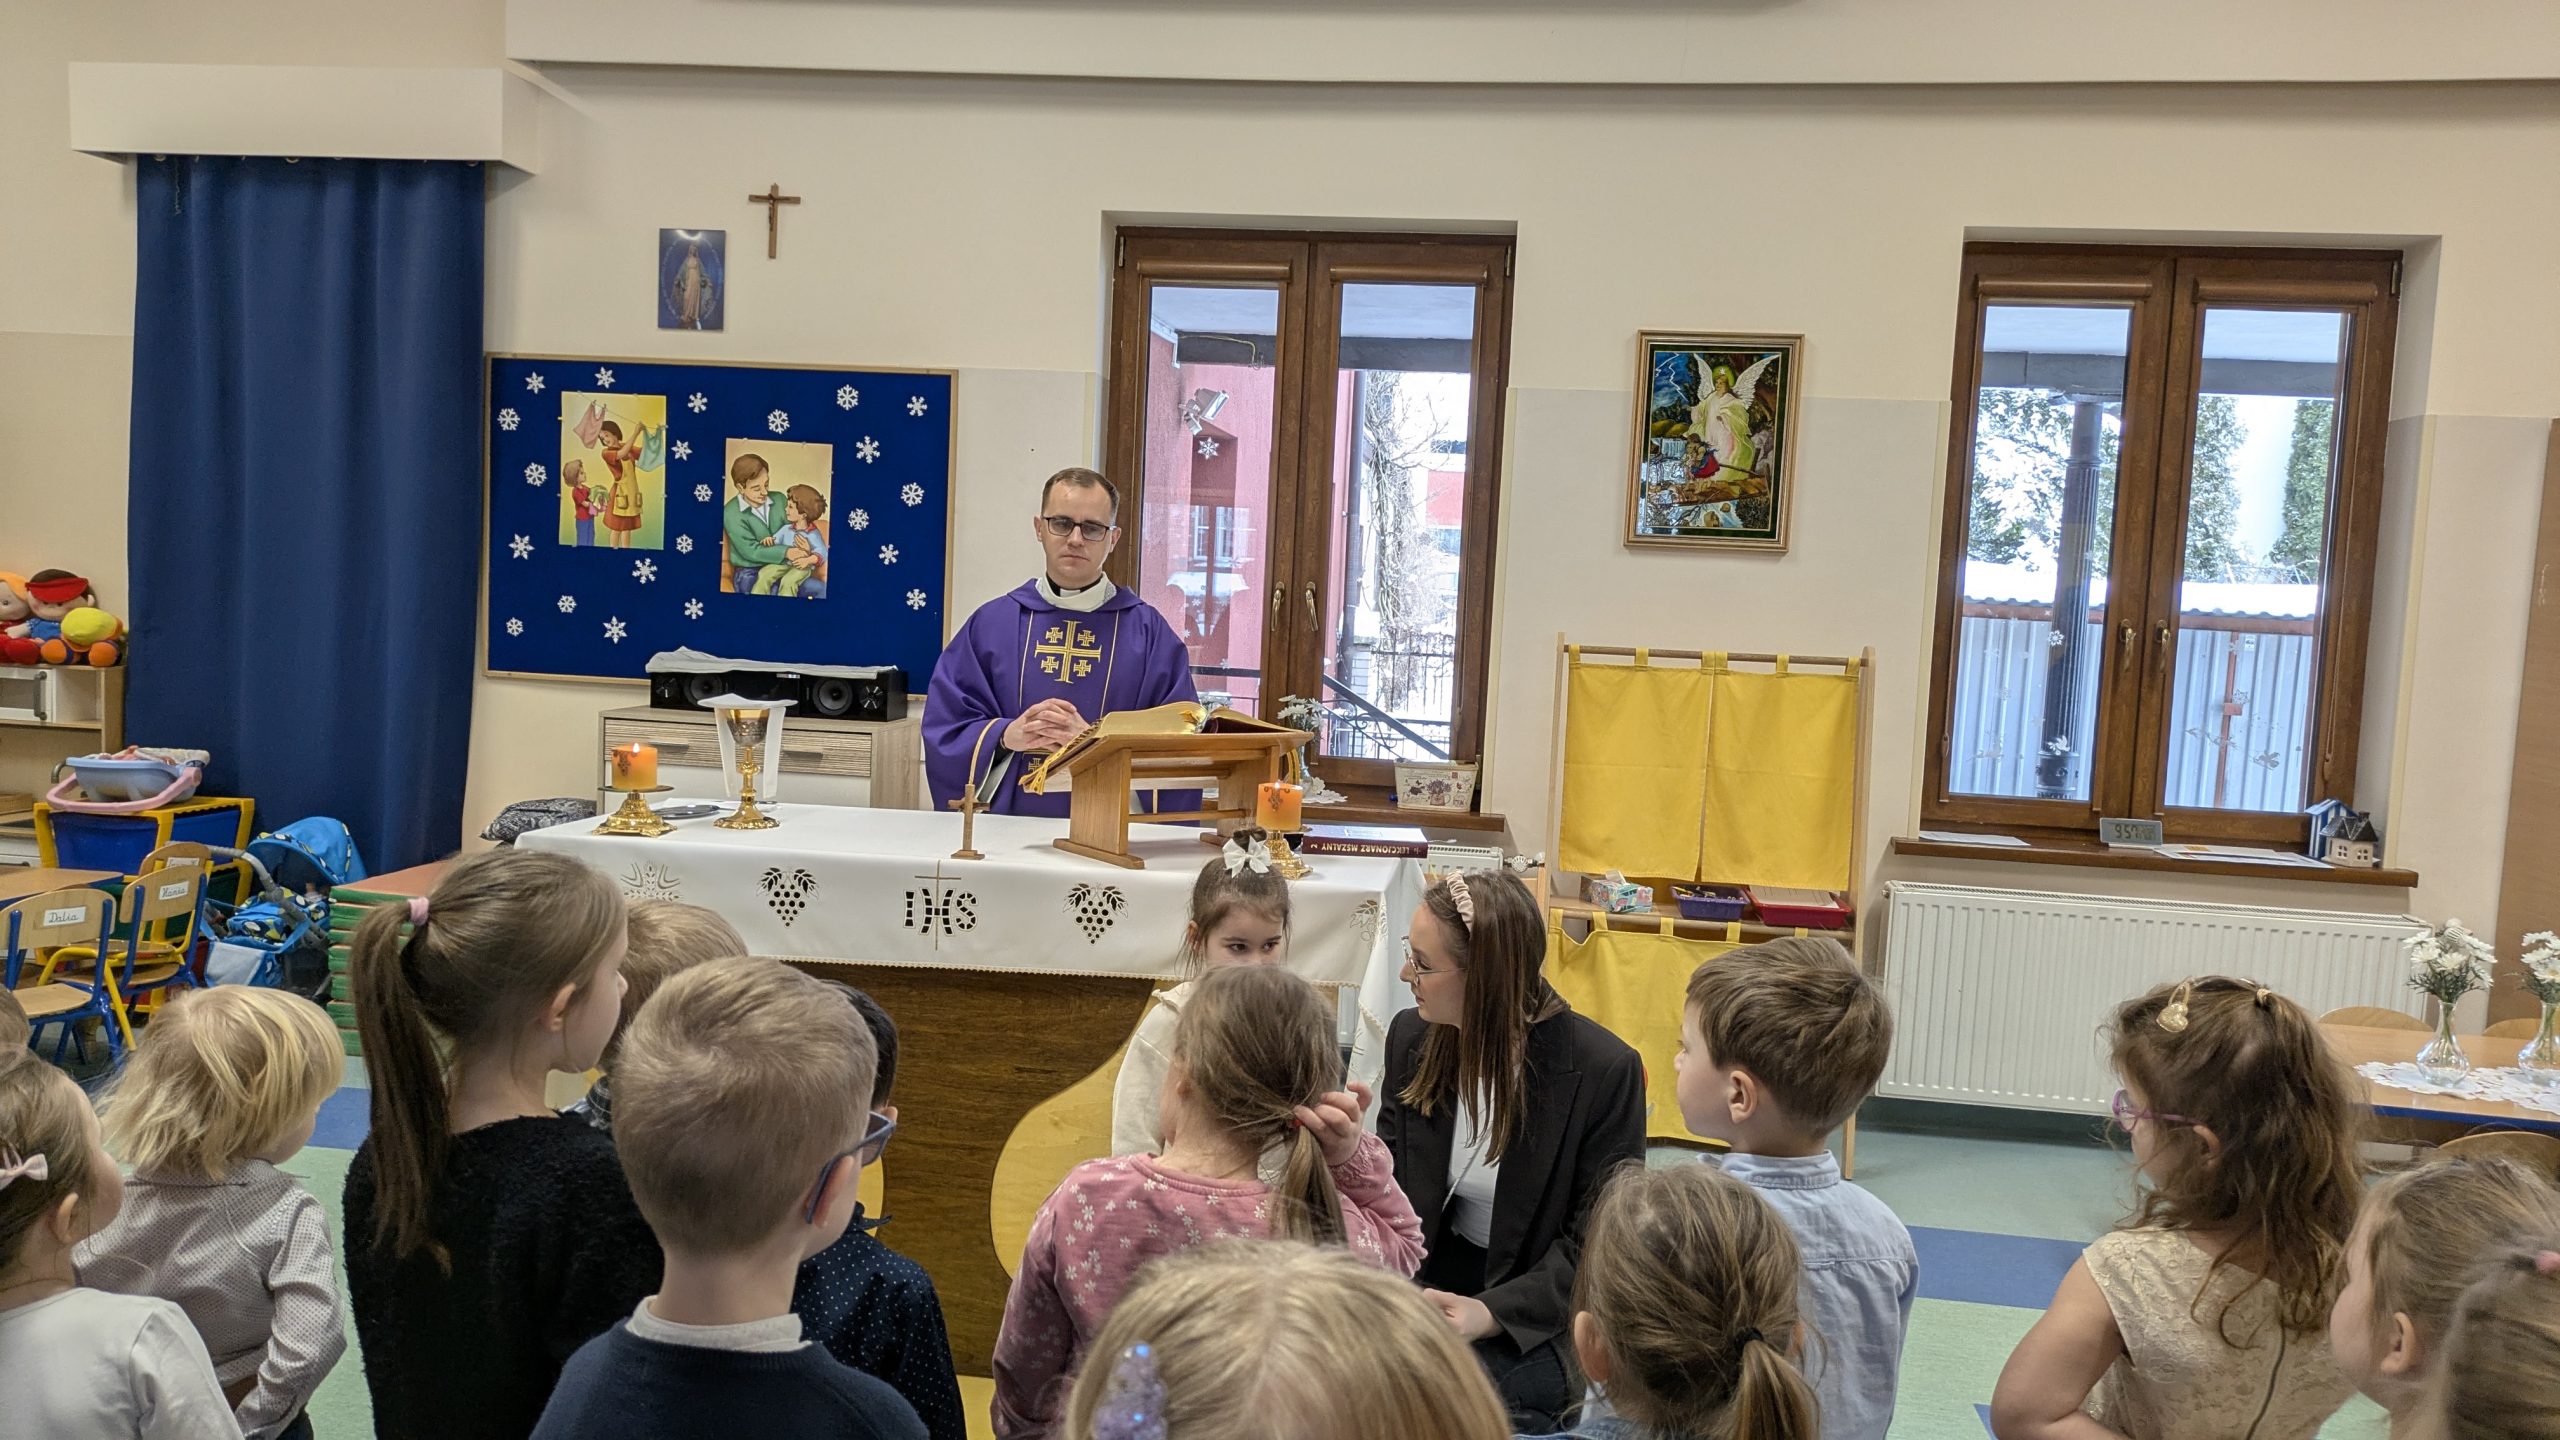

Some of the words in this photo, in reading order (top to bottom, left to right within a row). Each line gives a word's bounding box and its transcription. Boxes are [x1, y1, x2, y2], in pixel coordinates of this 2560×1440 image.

[1321, 842, 1359, 852] MSZALNY
[1360, 845, 1410, 854] LEKCJONARZ
[904, 888, 978, 936] IHS
